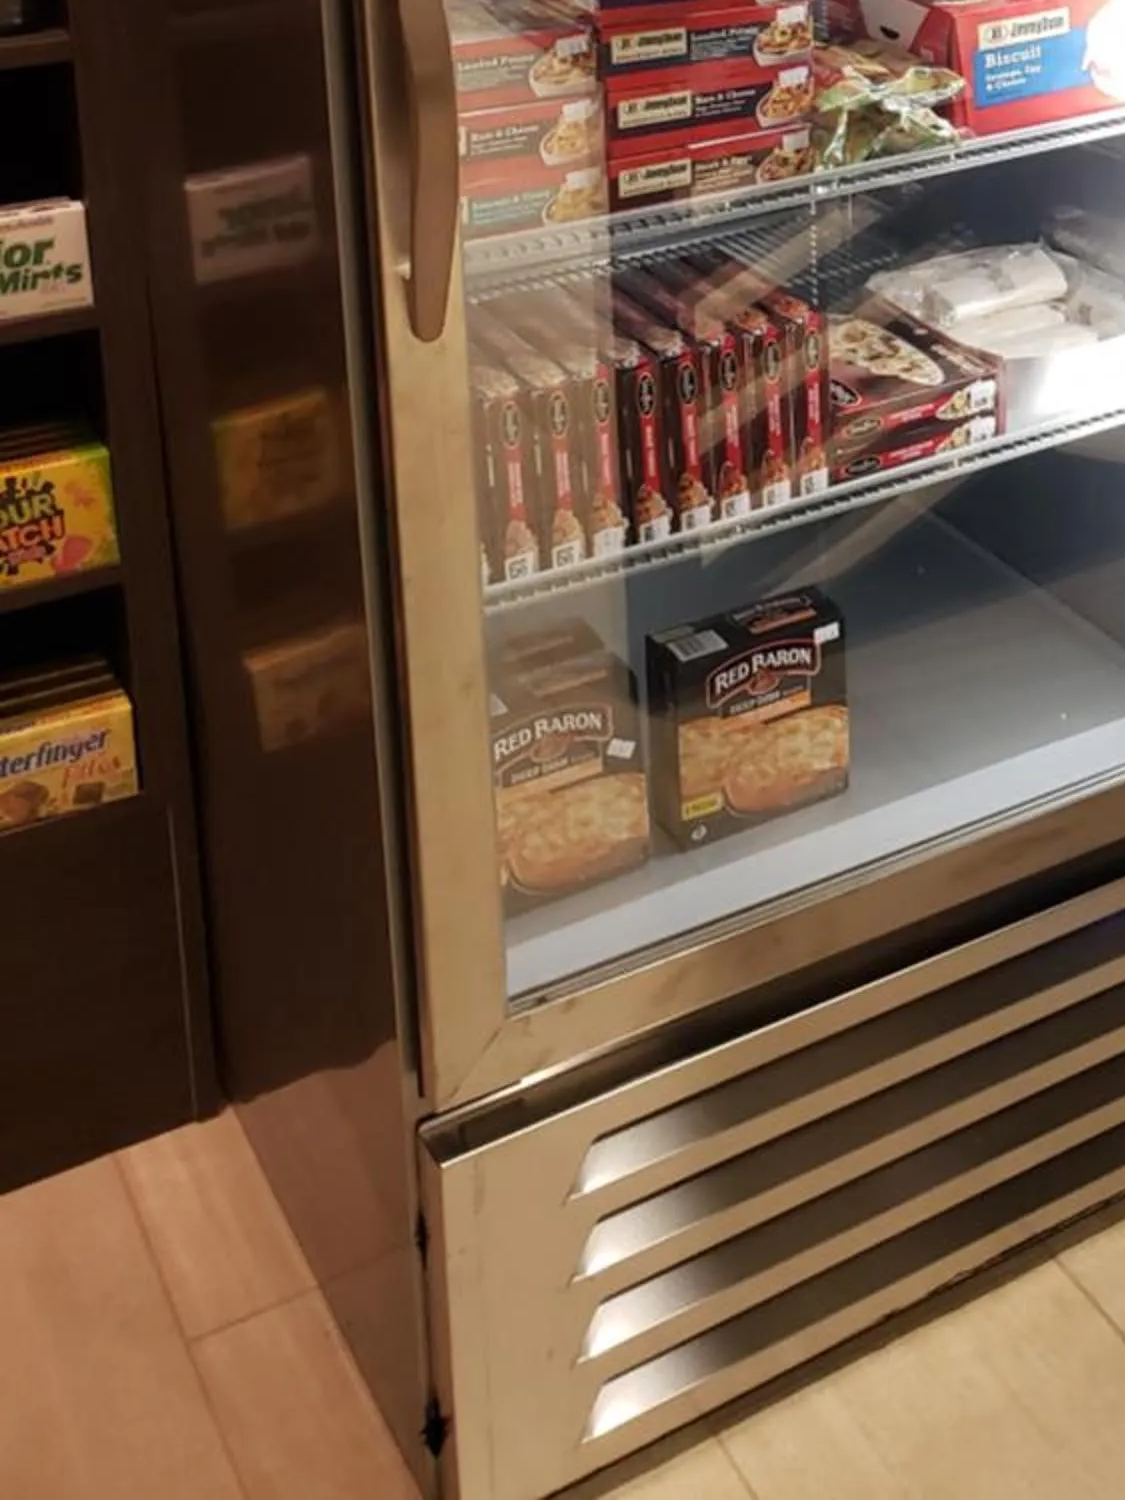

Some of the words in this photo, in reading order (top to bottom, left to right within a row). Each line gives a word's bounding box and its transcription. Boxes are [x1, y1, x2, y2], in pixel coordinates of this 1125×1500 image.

[985, 44, 1041, 68] Biscuit
[714, 661, 750, 697] RED
[751, 647, 812, 674] BARON
[494, 727, 532, 762] RED
[533, 711, 603, 740] BARON
